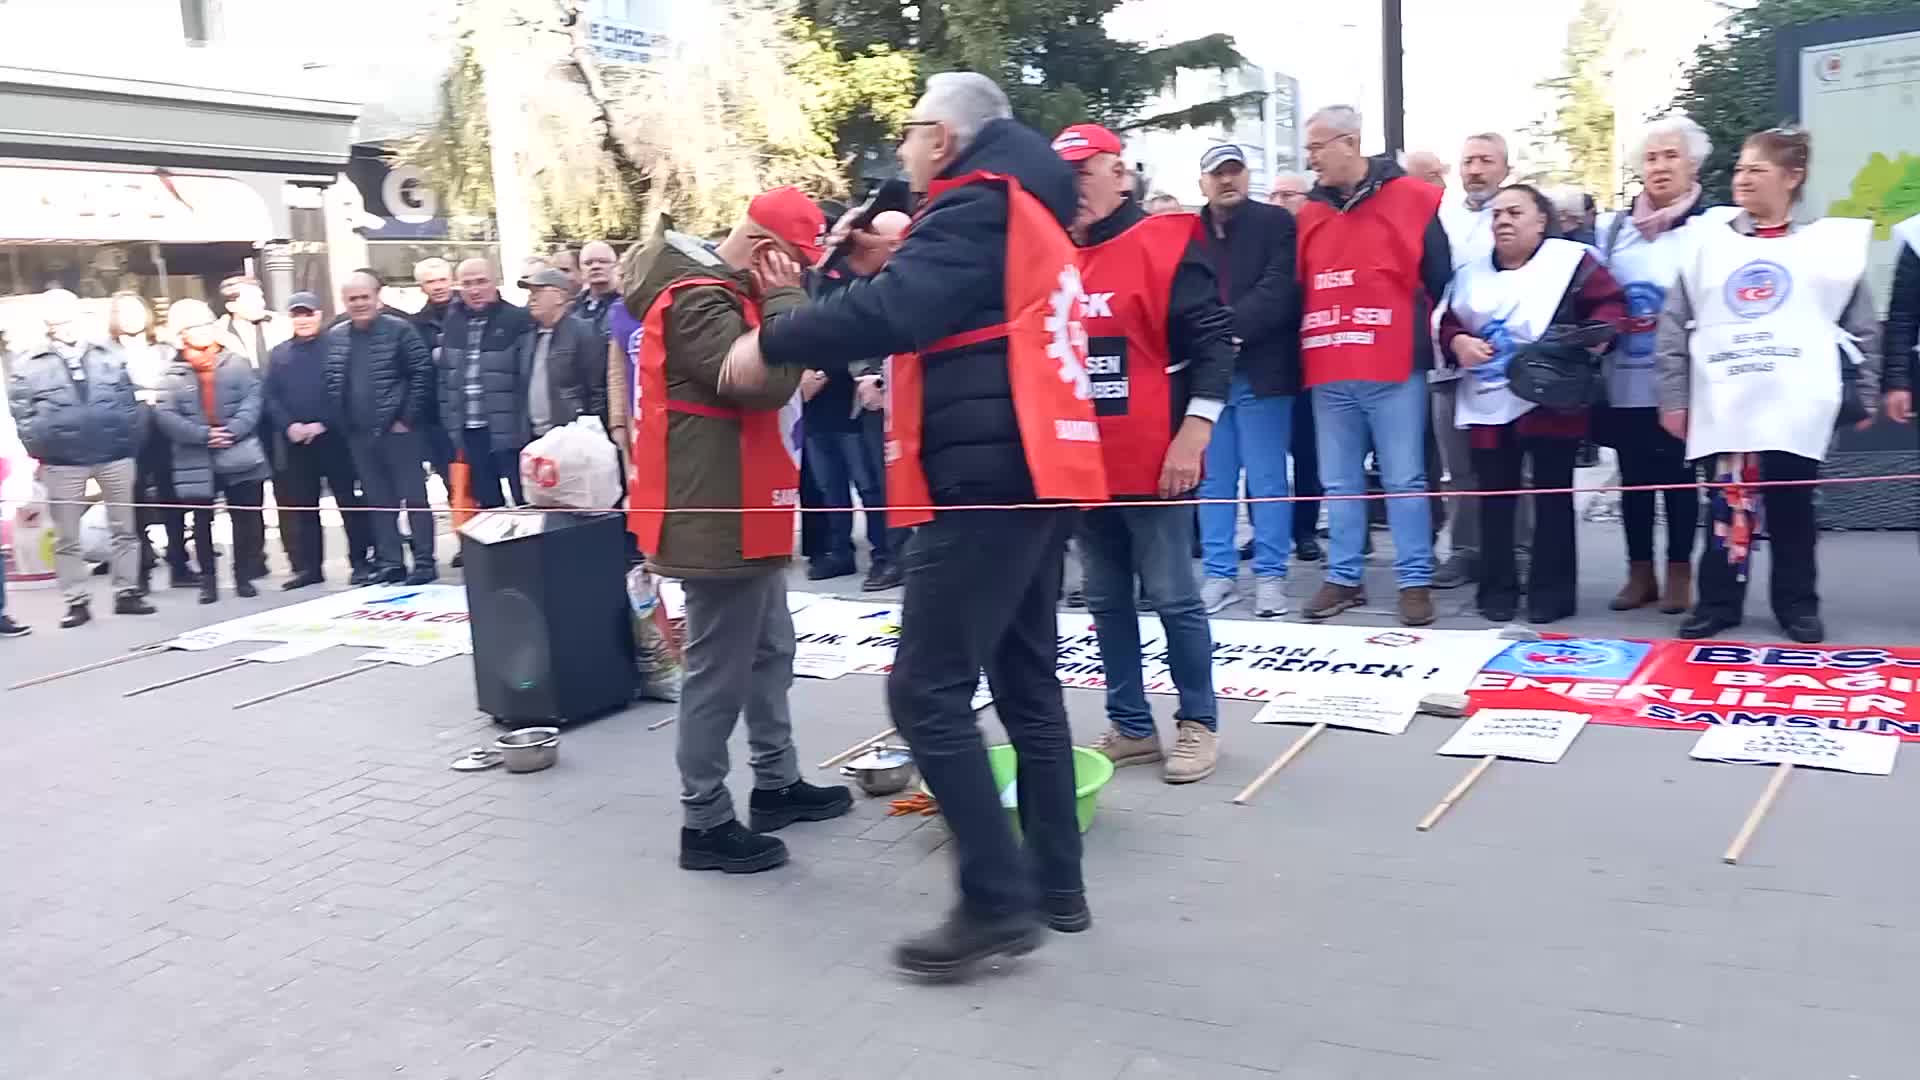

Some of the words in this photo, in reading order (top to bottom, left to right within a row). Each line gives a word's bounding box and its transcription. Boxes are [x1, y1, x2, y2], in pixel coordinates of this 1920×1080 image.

[1351, 307, 1393, 326] SEN
[1466, 672, 1907, 715] EMEKLİLER
[1711, 670, 1920, 694] BAĞI
[1643, 704, 1920, 734] SAMSUN
